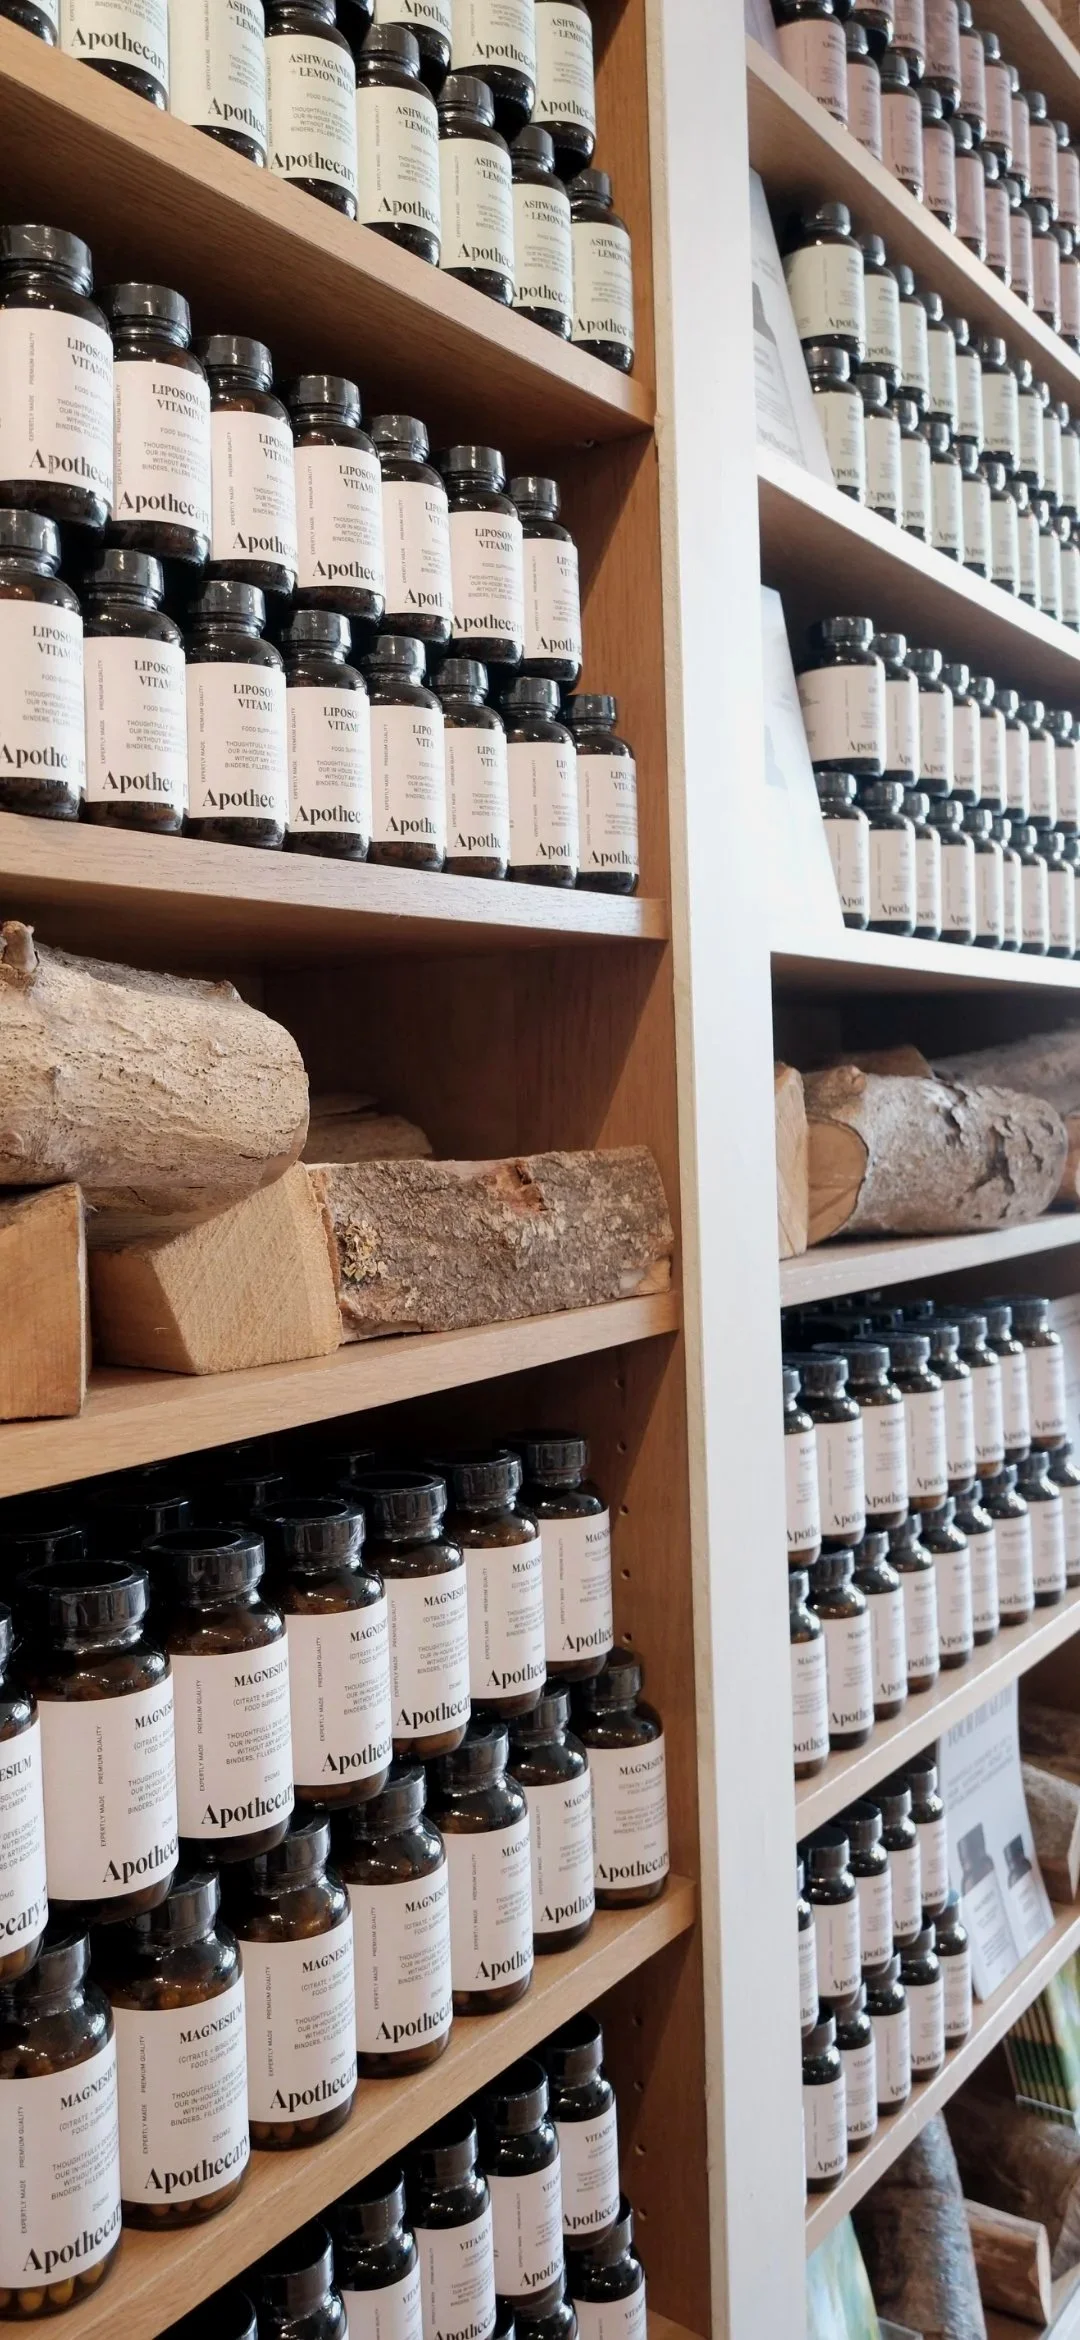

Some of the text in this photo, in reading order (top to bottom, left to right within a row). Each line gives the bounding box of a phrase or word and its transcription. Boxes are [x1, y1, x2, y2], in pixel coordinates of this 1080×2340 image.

[472, 41, 533, 69] Apothec
[300, 67, 335, 82] LEMON
[208, 97, 265, 137] Apothec
[537, 99, 590, 120] Apothec
[378, 197, 439, 227] Apothec
[458, 243, 513, 269] Apothec
[575, 318, 628, 337] Apothec
[152, 384, 204, 410] LIPOSOM
[312, 560, 376, 581] Apothec
[454, 614, 518, 633] Apothec
[0, 743, 69, 769] Apothe
[102, 770, 172, 794] Apothe
[202, 788, 275, 811] Apothec
[295, 805, 360, 826] Apothec
[487, 1661, 545, 1690] Apothec
[396, 1695, 471, 1730] Apotheca
[0, 1755, 32, 1781] ESIUM
[322, 1736, 392, 1775] Apothec
[103, 1834, 178, 1884] Apothec
[595, 1851, 668, 1882] Apothecar
[174, 2099, 190, 2109] OUR
